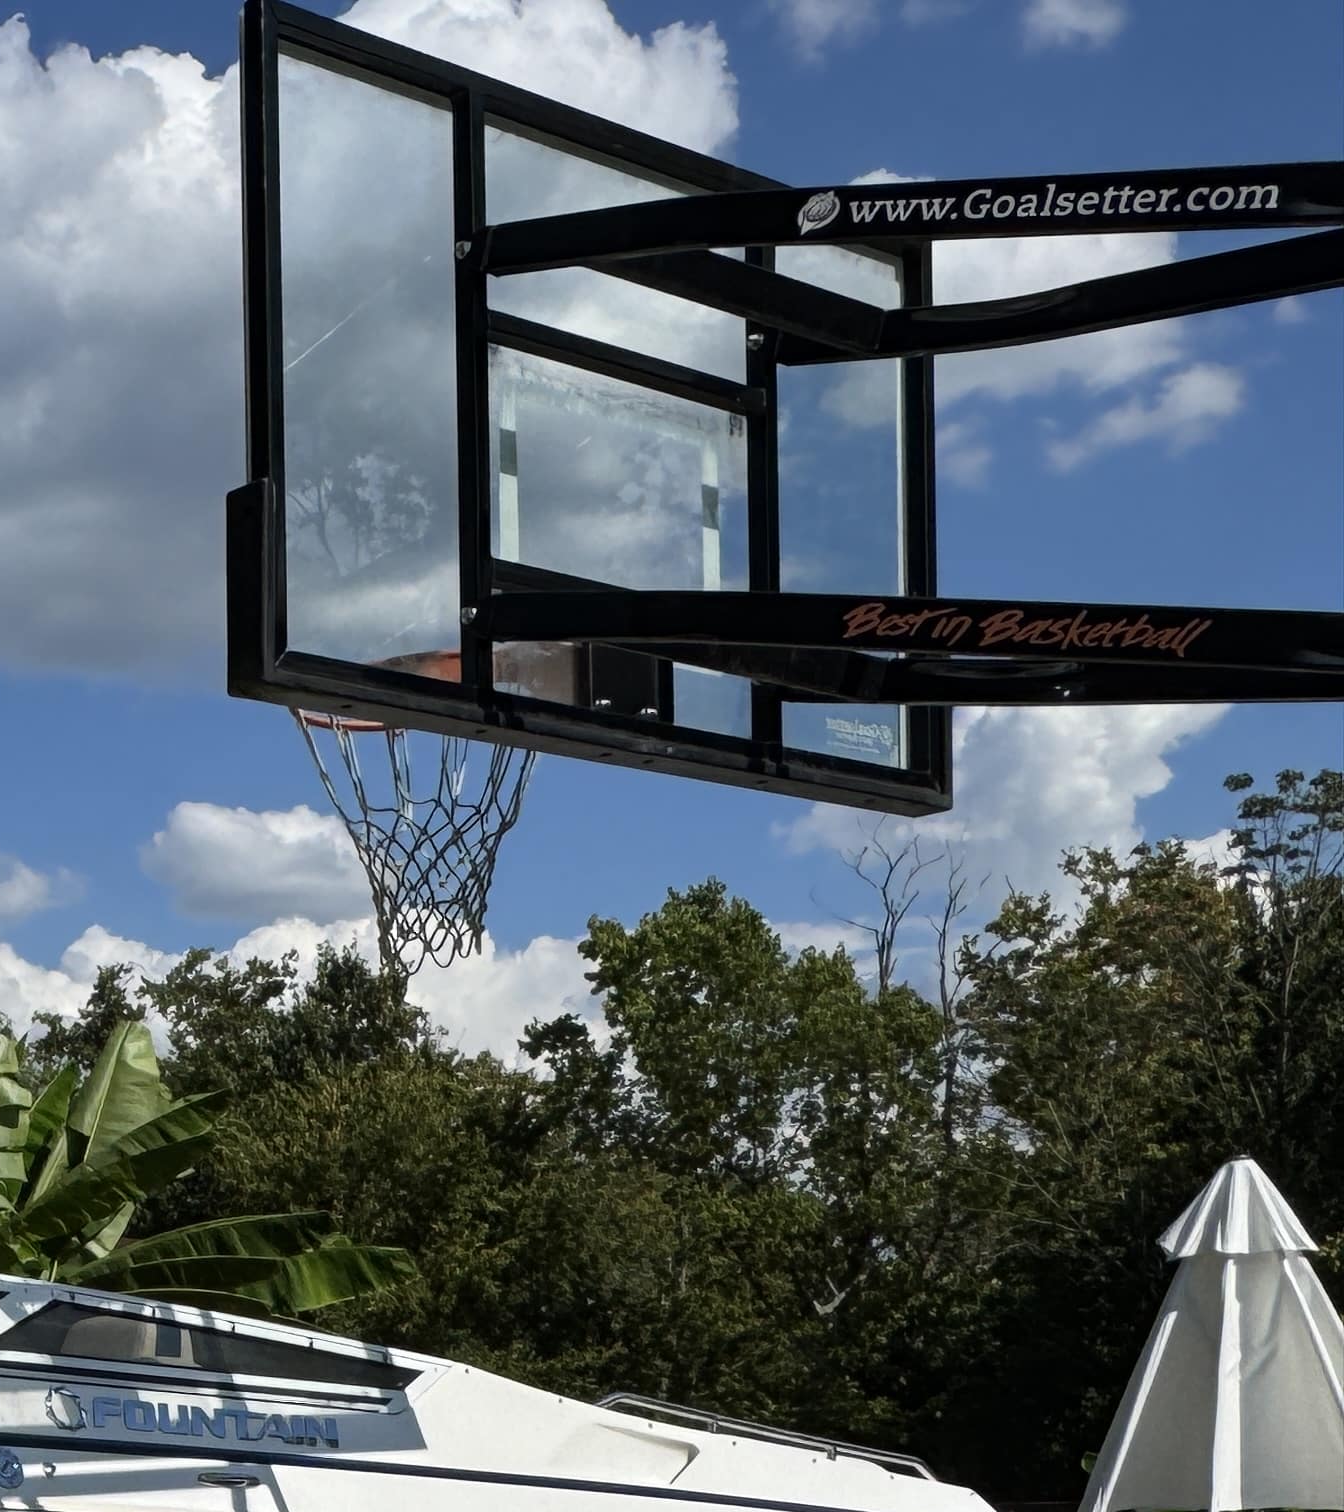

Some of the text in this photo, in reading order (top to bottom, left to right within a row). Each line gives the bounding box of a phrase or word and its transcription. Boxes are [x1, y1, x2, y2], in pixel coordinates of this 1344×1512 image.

[849, 184, 1279, 223] www.Goalsetter.com
[843, 602, 1213, 658] Best in Basketball
[93, 1398, 340, 1449] FOUNTAIN
